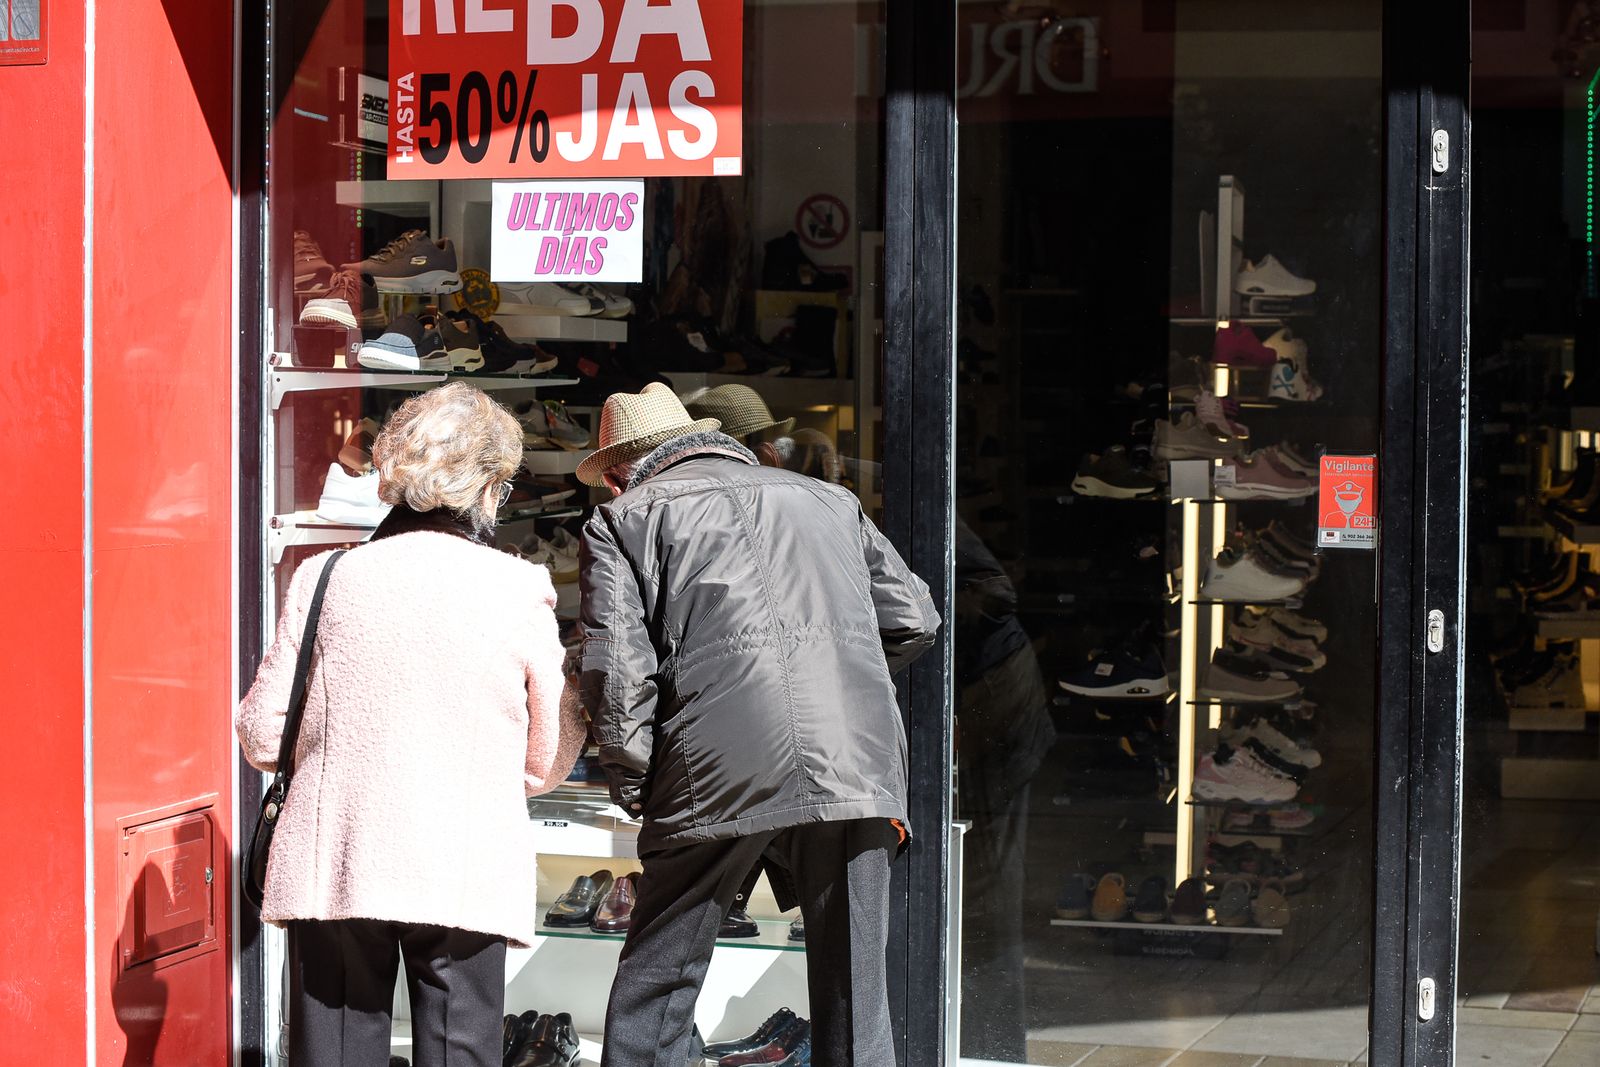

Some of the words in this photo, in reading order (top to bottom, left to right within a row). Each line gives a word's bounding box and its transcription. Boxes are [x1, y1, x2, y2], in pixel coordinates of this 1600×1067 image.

[396, 72, 415, 163] HASTA
[418, 70, 550, 165] 50%
[556, 70, 718, 162] JAS
[507, 192, 638, 231] ULTIMOS
[535, 226, 607, 275] DÍAS
[1325, 460, 1375, 473] Vigilante
[1355, 517, 1375, 527] 24H
